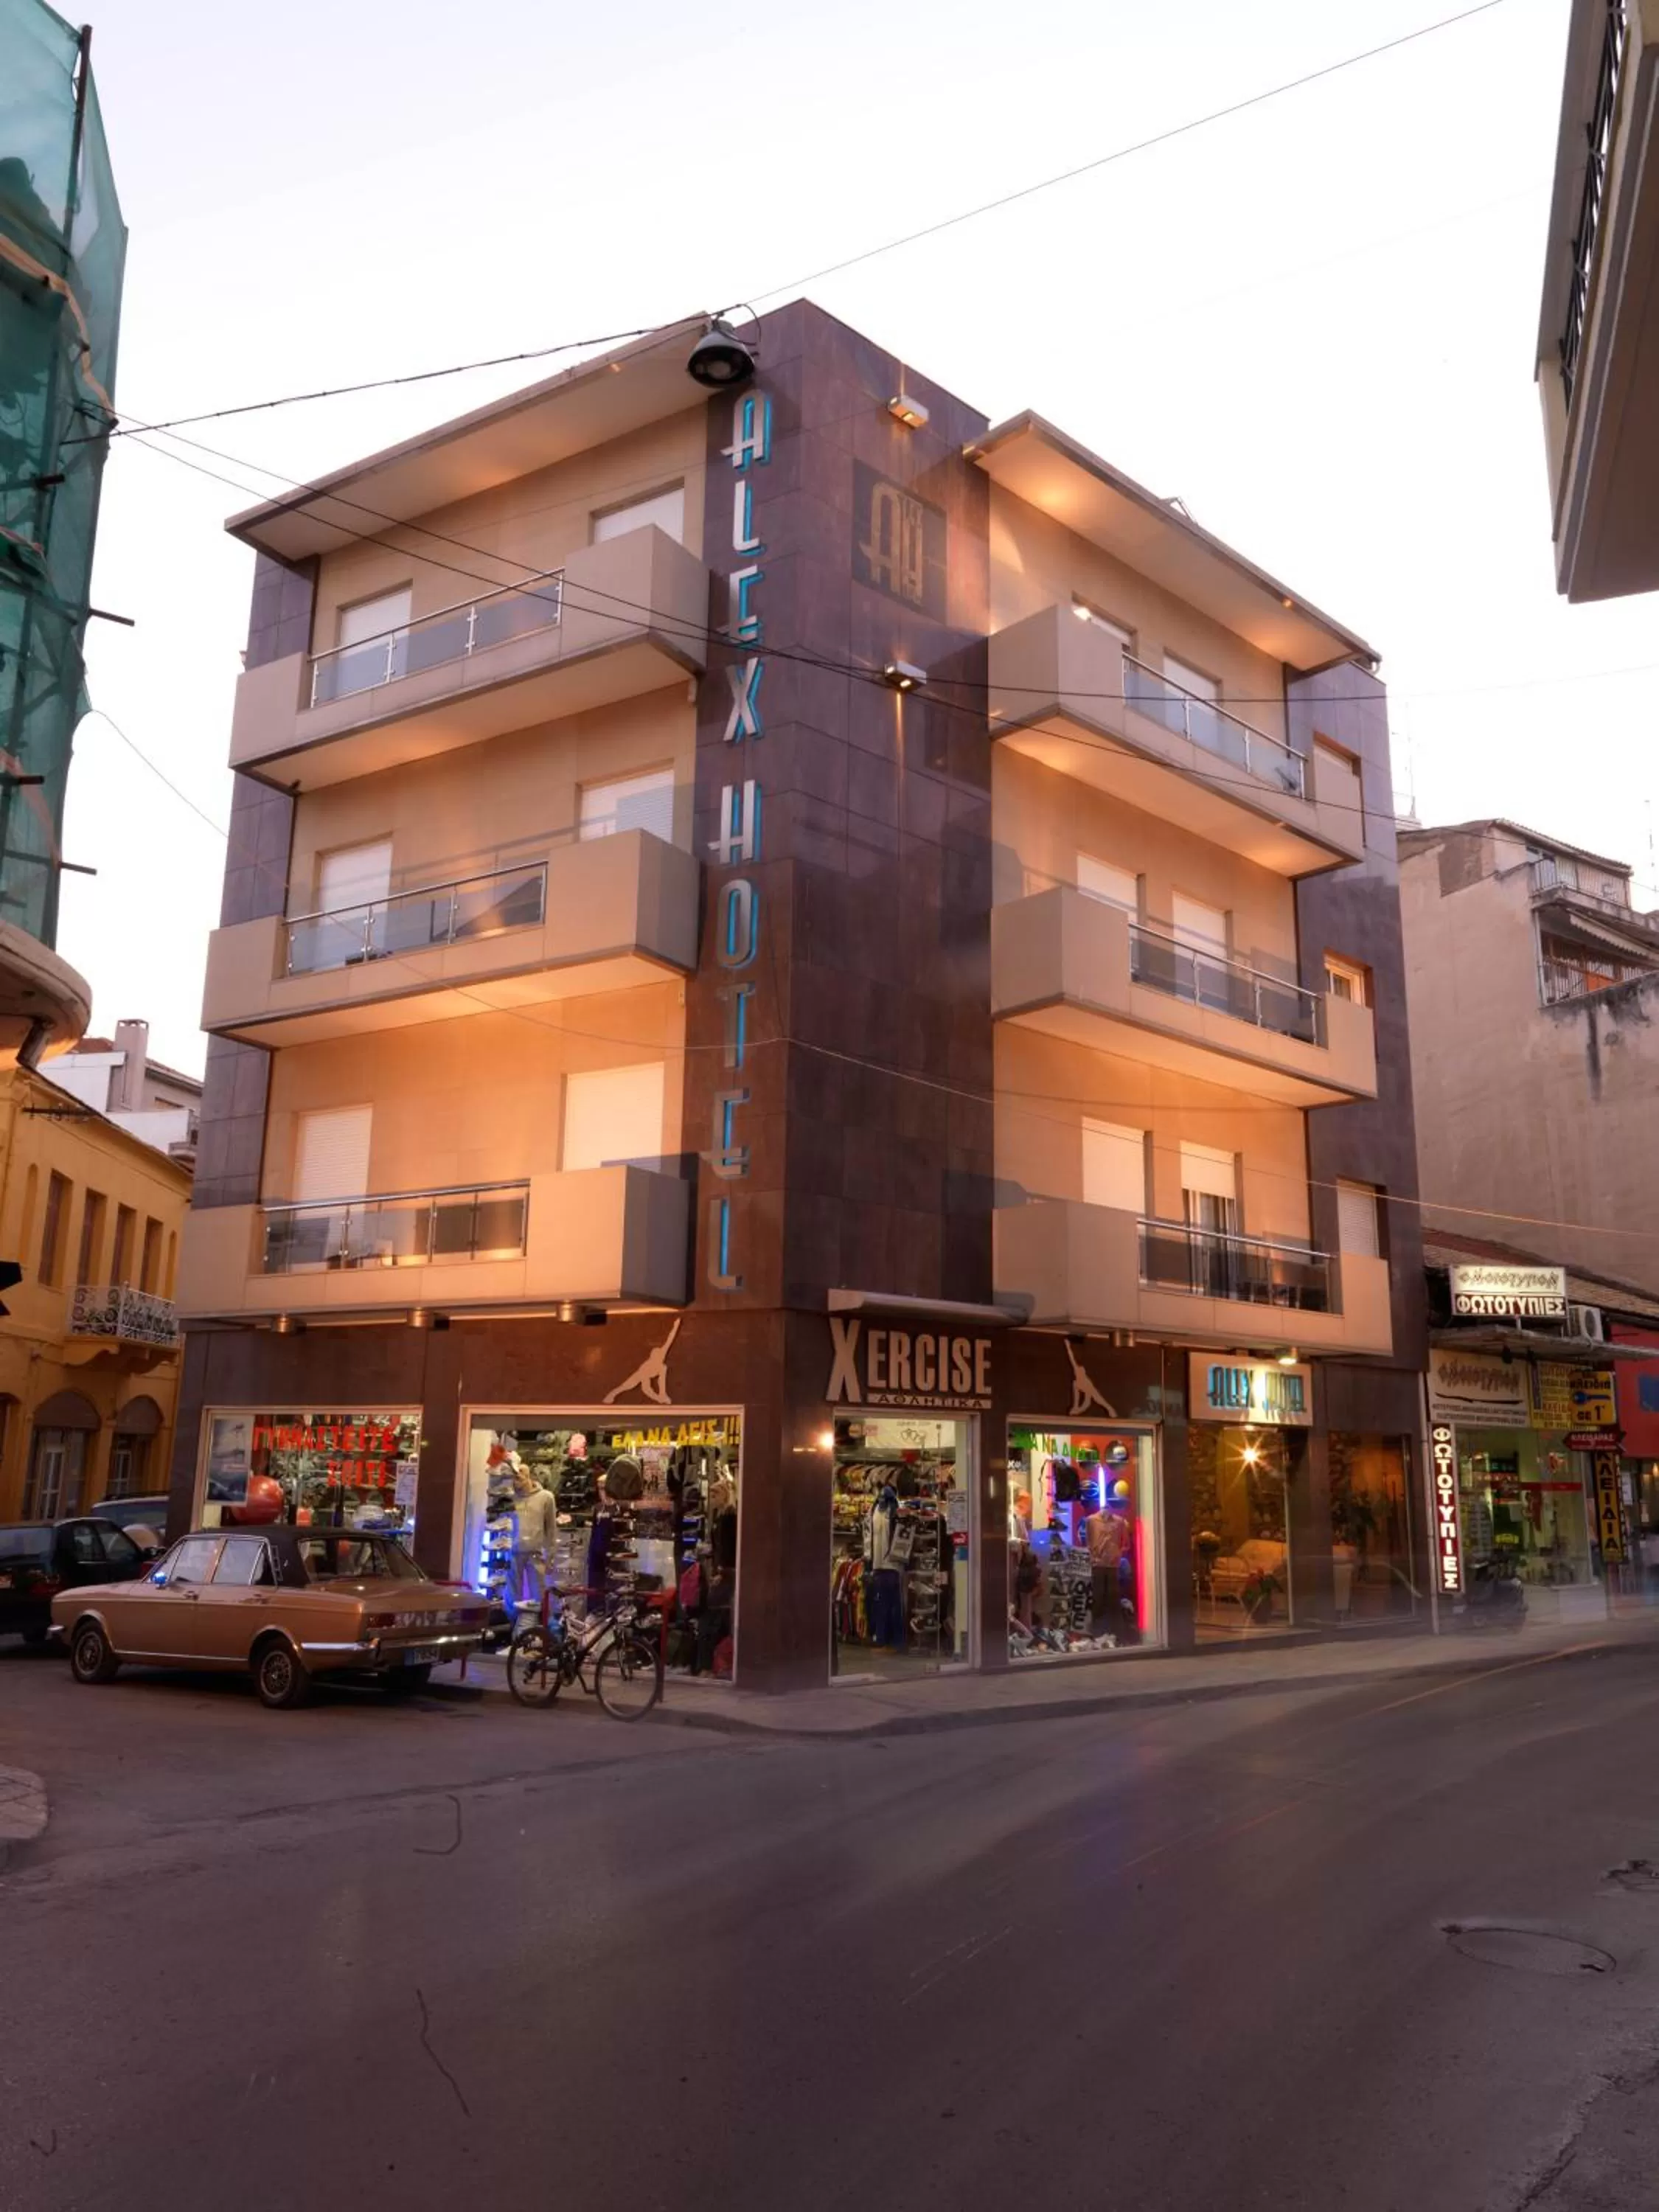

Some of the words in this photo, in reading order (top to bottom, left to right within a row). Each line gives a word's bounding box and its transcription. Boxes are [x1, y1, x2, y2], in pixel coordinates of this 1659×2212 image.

[699, 779, 762, 1292] HOTEL
[1456, 1295, 1565, 1315] ΦΩΤΟΤΥΠΙΕΣ
[825, 1317, 992, 1403] XERCISE
[877, 1394, 984, 1408] ΑΘΛΗΤΙΚΑ
[1433, 1427, 1458, 1589] ΦΩΤΟΤΥΠΙΕΣ
